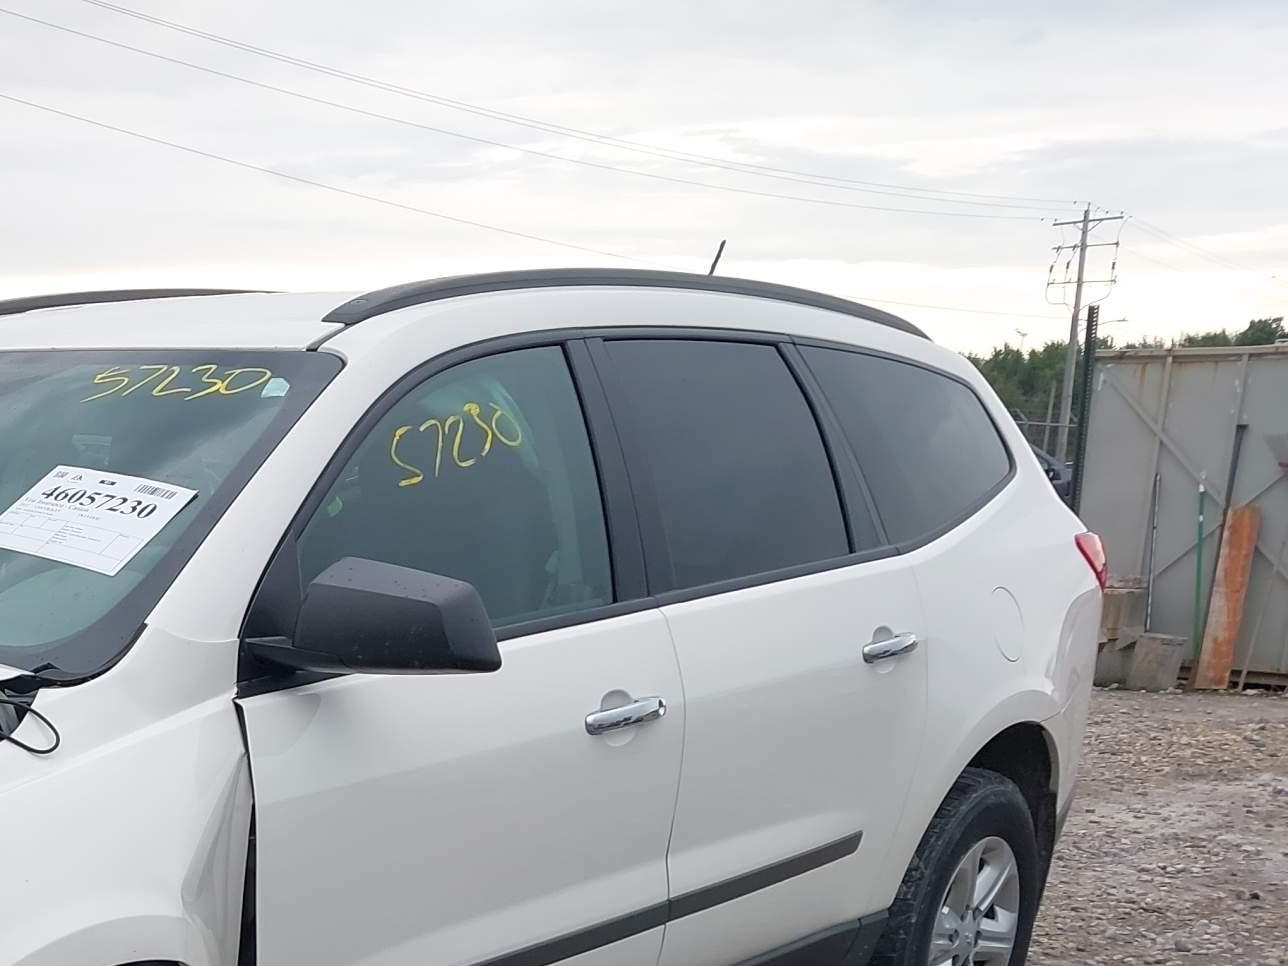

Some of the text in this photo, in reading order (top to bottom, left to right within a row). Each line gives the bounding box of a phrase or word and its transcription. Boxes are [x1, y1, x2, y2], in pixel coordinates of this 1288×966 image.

[80, 364, 272, 403] 57230
[391, 402, 522, 487] 57230
[41, 485, 158, 519] 46057230
